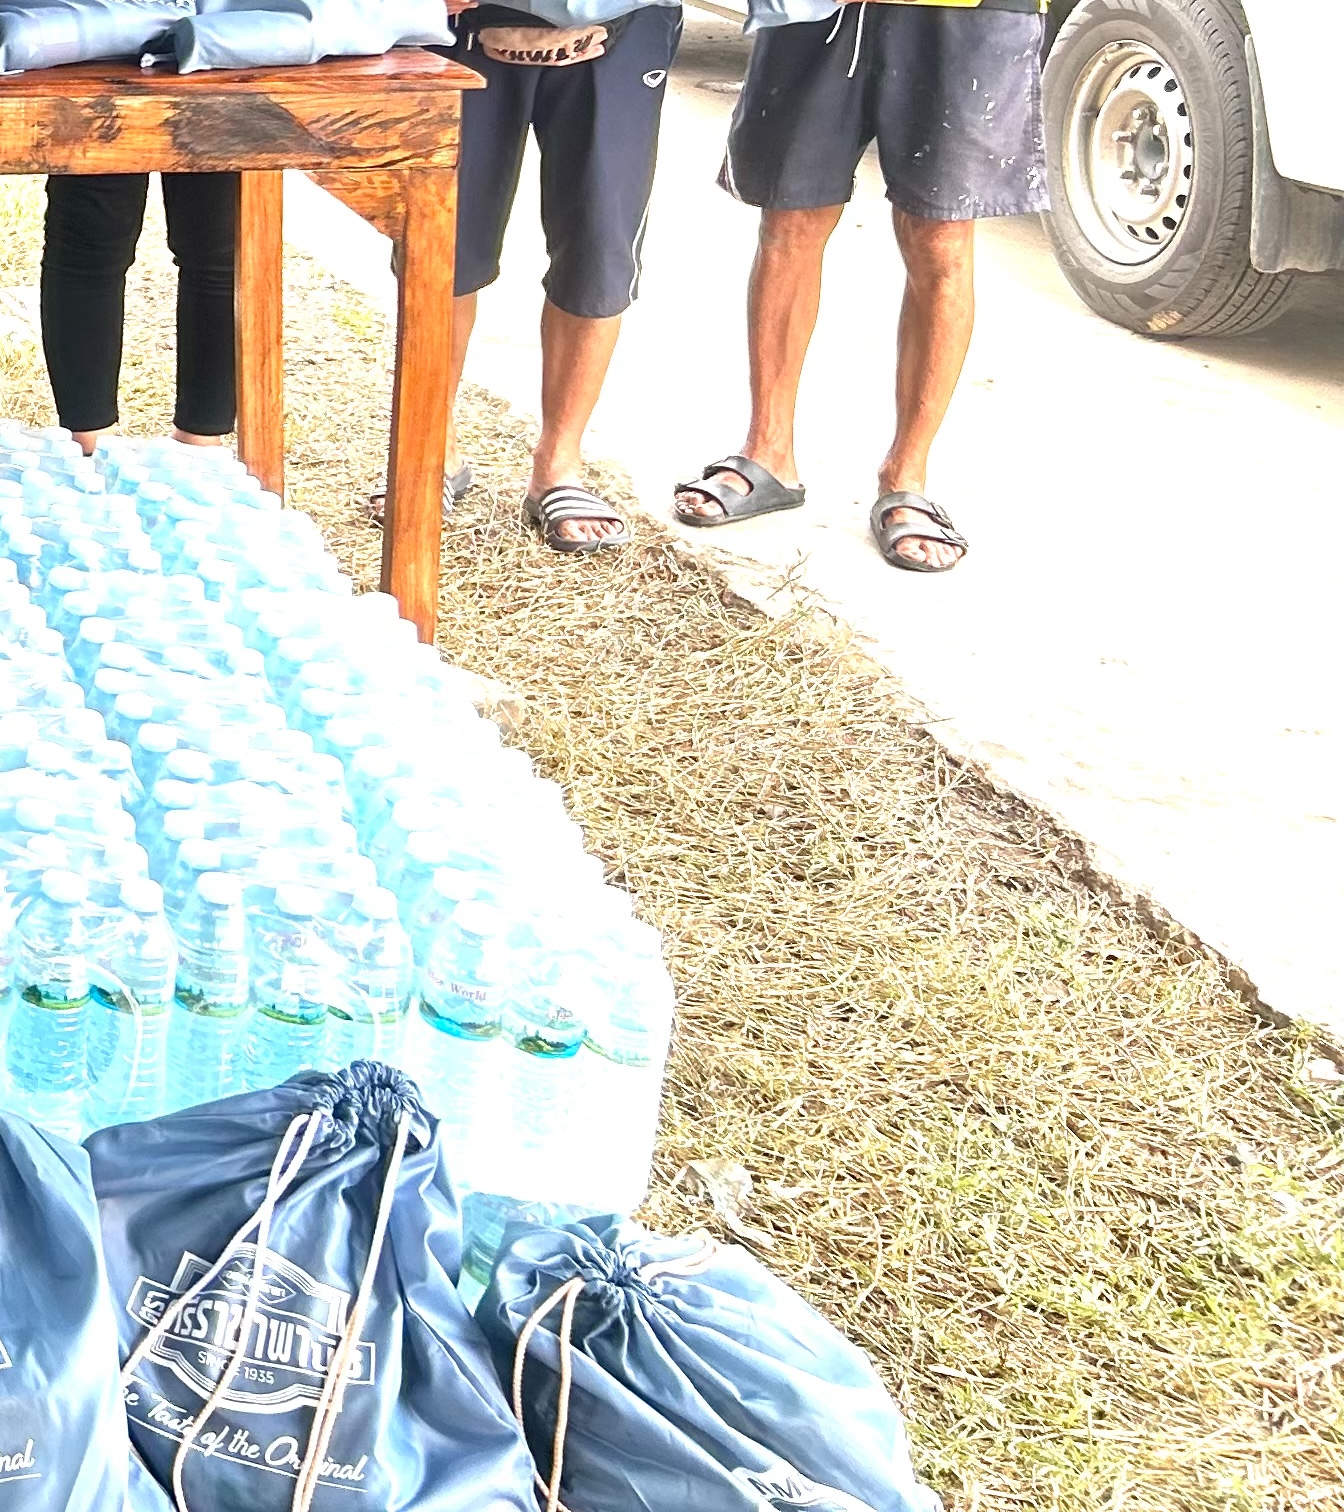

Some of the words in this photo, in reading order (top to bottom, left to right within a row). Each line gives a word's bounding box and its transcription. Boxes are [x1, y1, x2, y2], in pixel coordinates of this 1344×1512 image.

[243, 1366, 276, 1385] 1935
[202, 1430, 226, 1456] of
[230, 1430, 261, 1460] the
